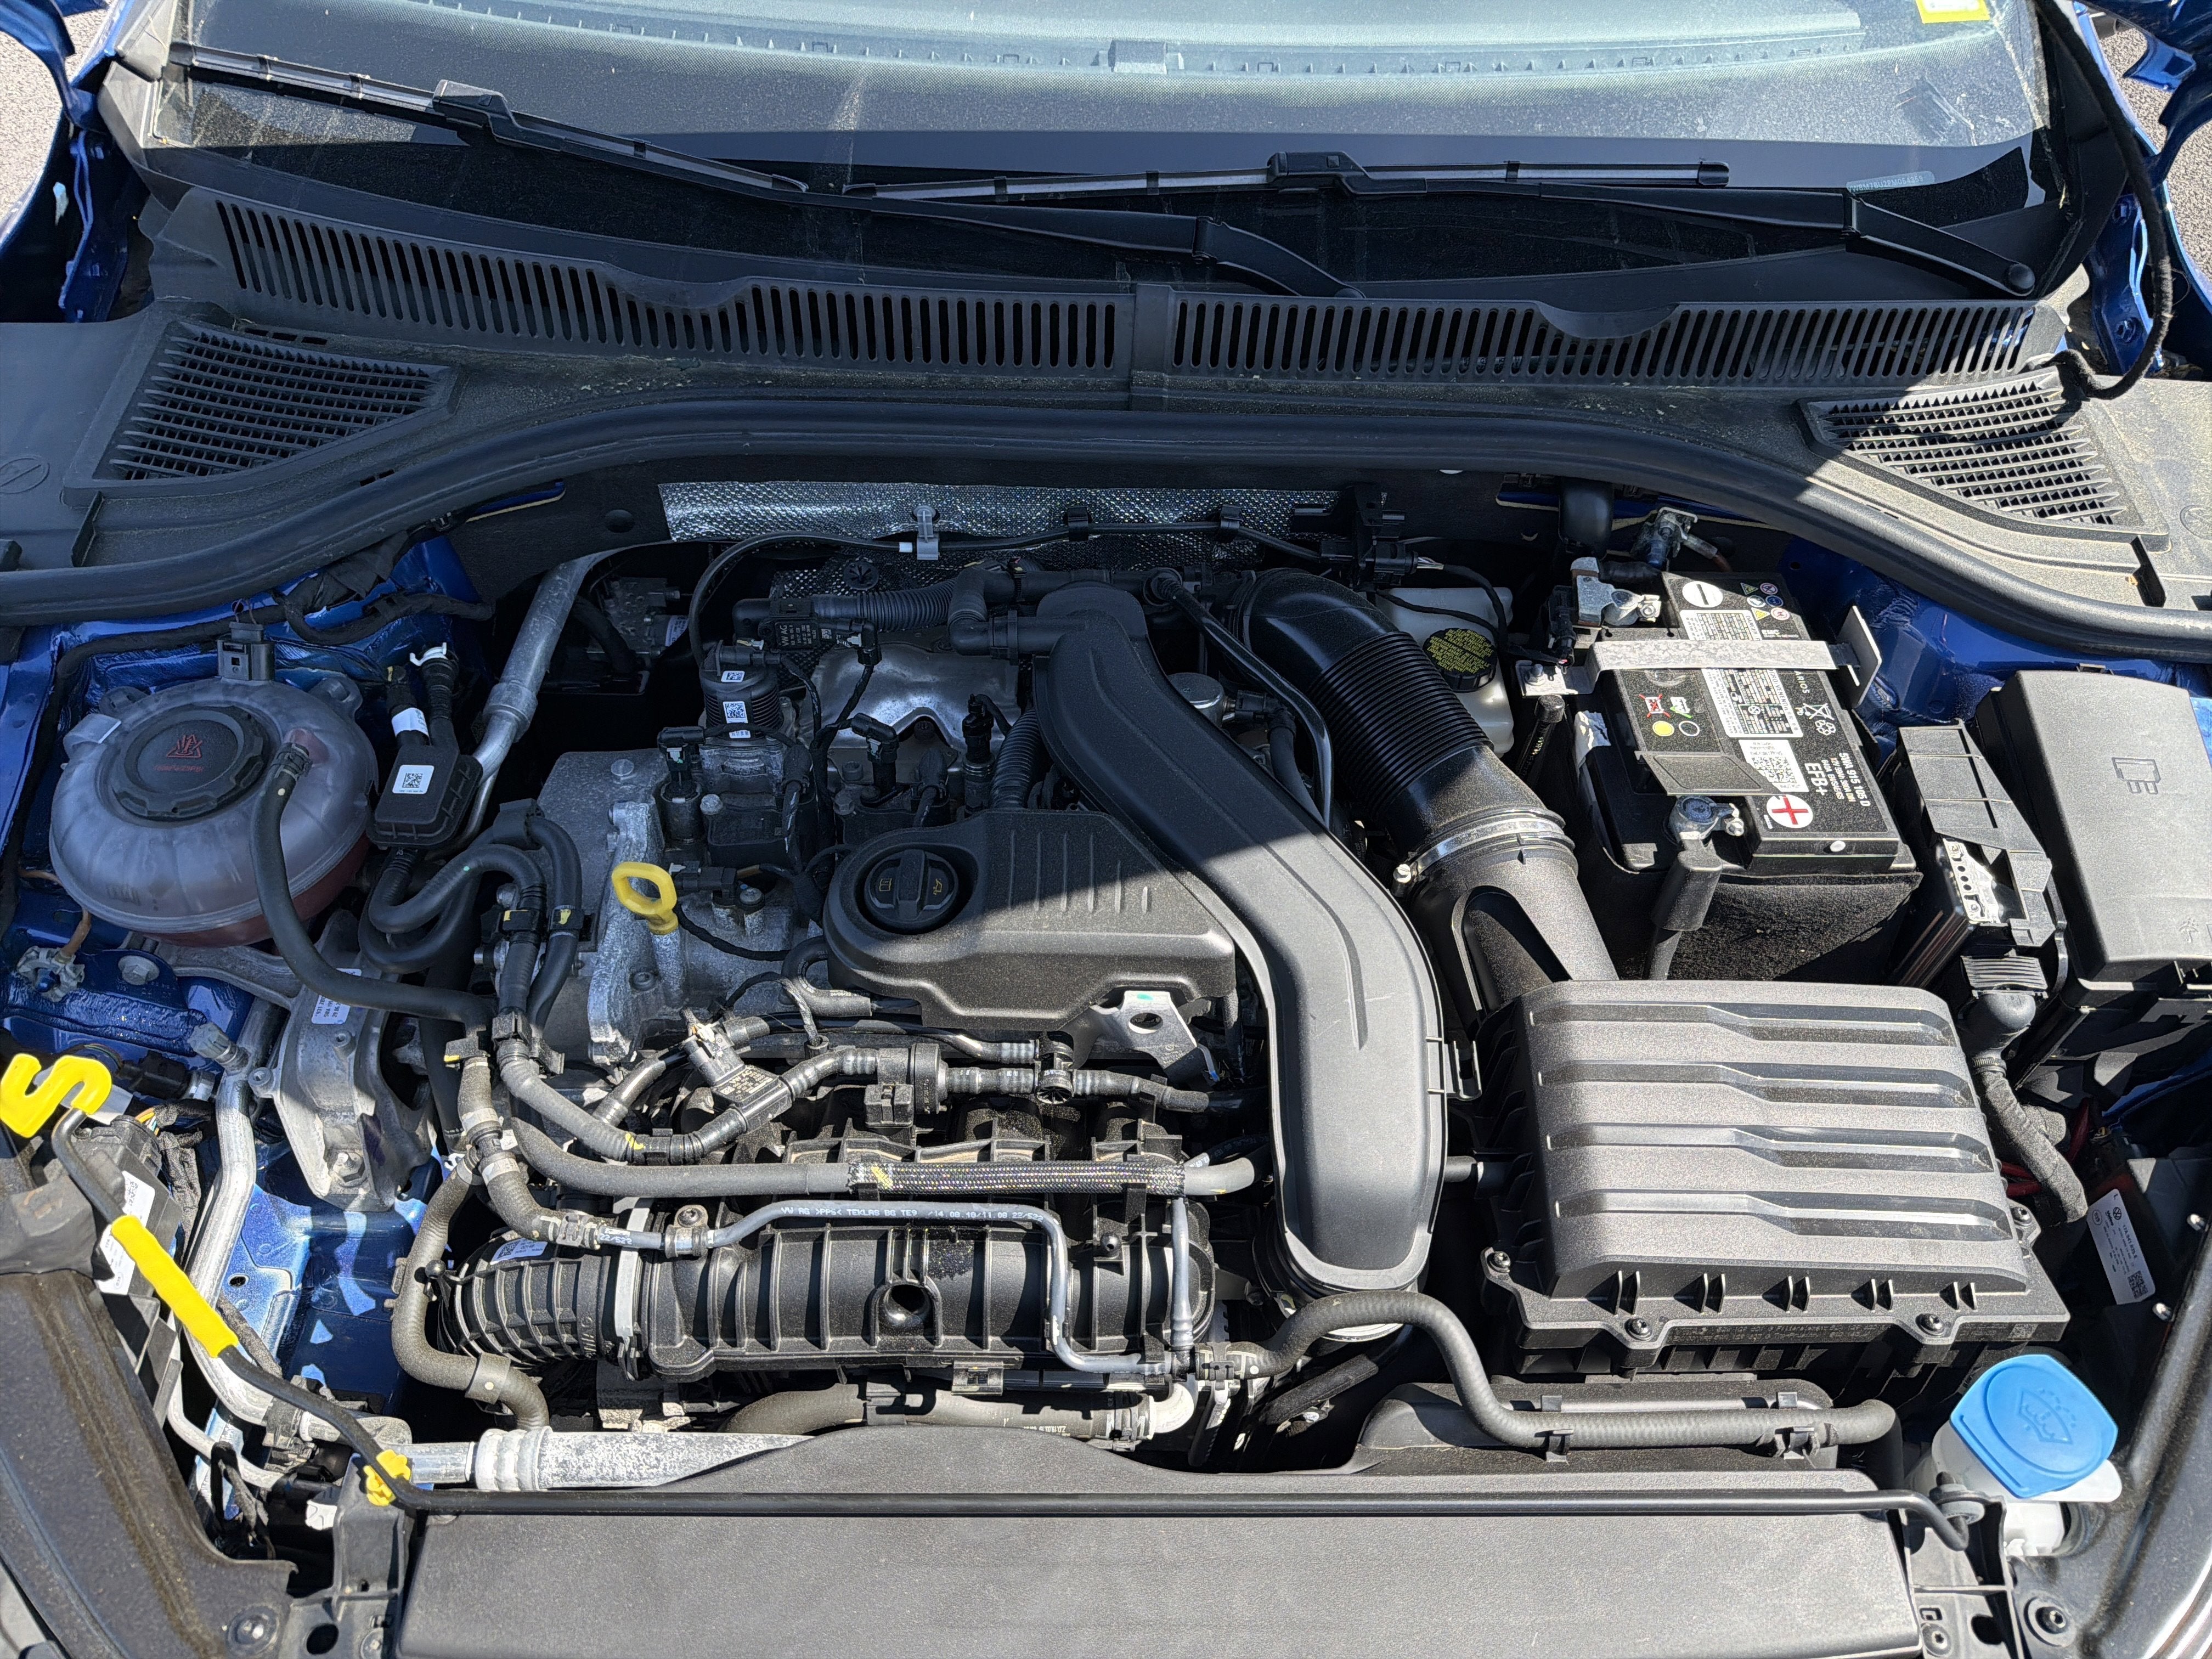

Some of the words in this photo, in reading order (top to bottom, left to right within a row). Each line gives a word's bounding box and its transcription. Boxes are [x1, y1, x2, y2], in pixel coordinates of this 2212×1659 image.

[1794, 671, 1810, 693] ARIOS
[1804, 763, 1828, 795] EFB+
[1839, 753, 1853, 769] 5WA
[1847, 770, 1860, 783] 915
[1854, 785, 1867, 799] 105
